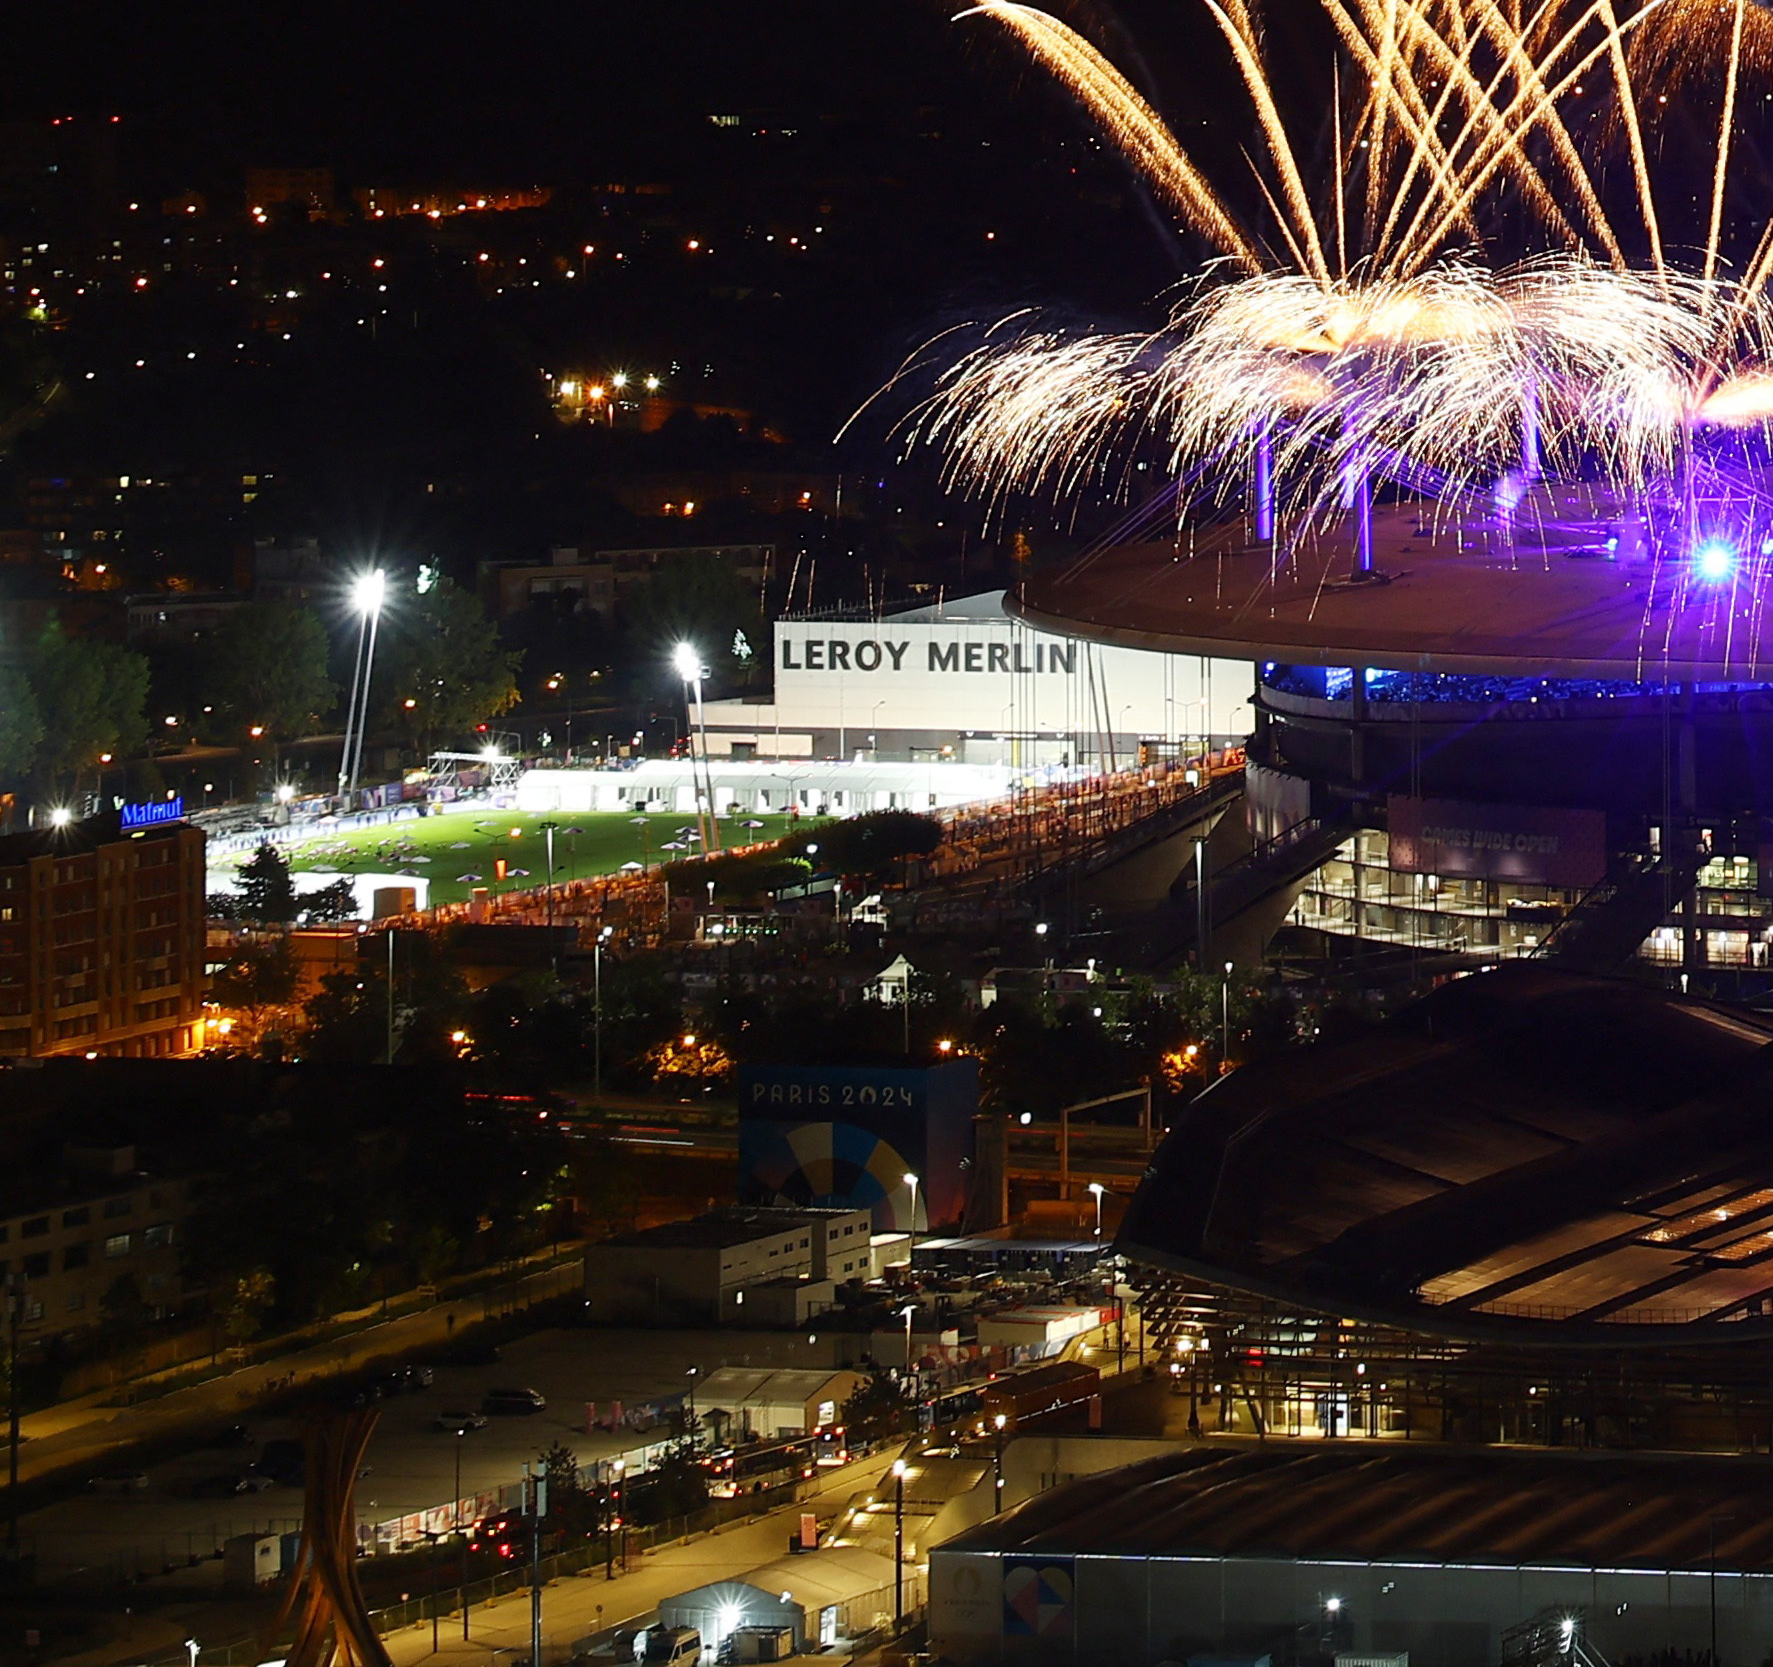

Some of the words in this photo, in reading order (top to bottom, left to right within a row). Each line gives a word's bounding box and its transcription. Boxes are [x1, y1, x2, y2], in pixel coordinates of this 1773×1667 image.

[782, 639, 910, 671] LEROY
[928, 642, 1076, 673] MERLIN
[121, 796, 184, 826] Matmut
[1422, 826, 1471, 848] GAMES
[1473, 830, 1512, 851] WIDE
[1515, 835, 1560, 854] OPEN
[751, 1083, 831, 1105] PARIS
[842, 1085, 913, 1107] 2024
